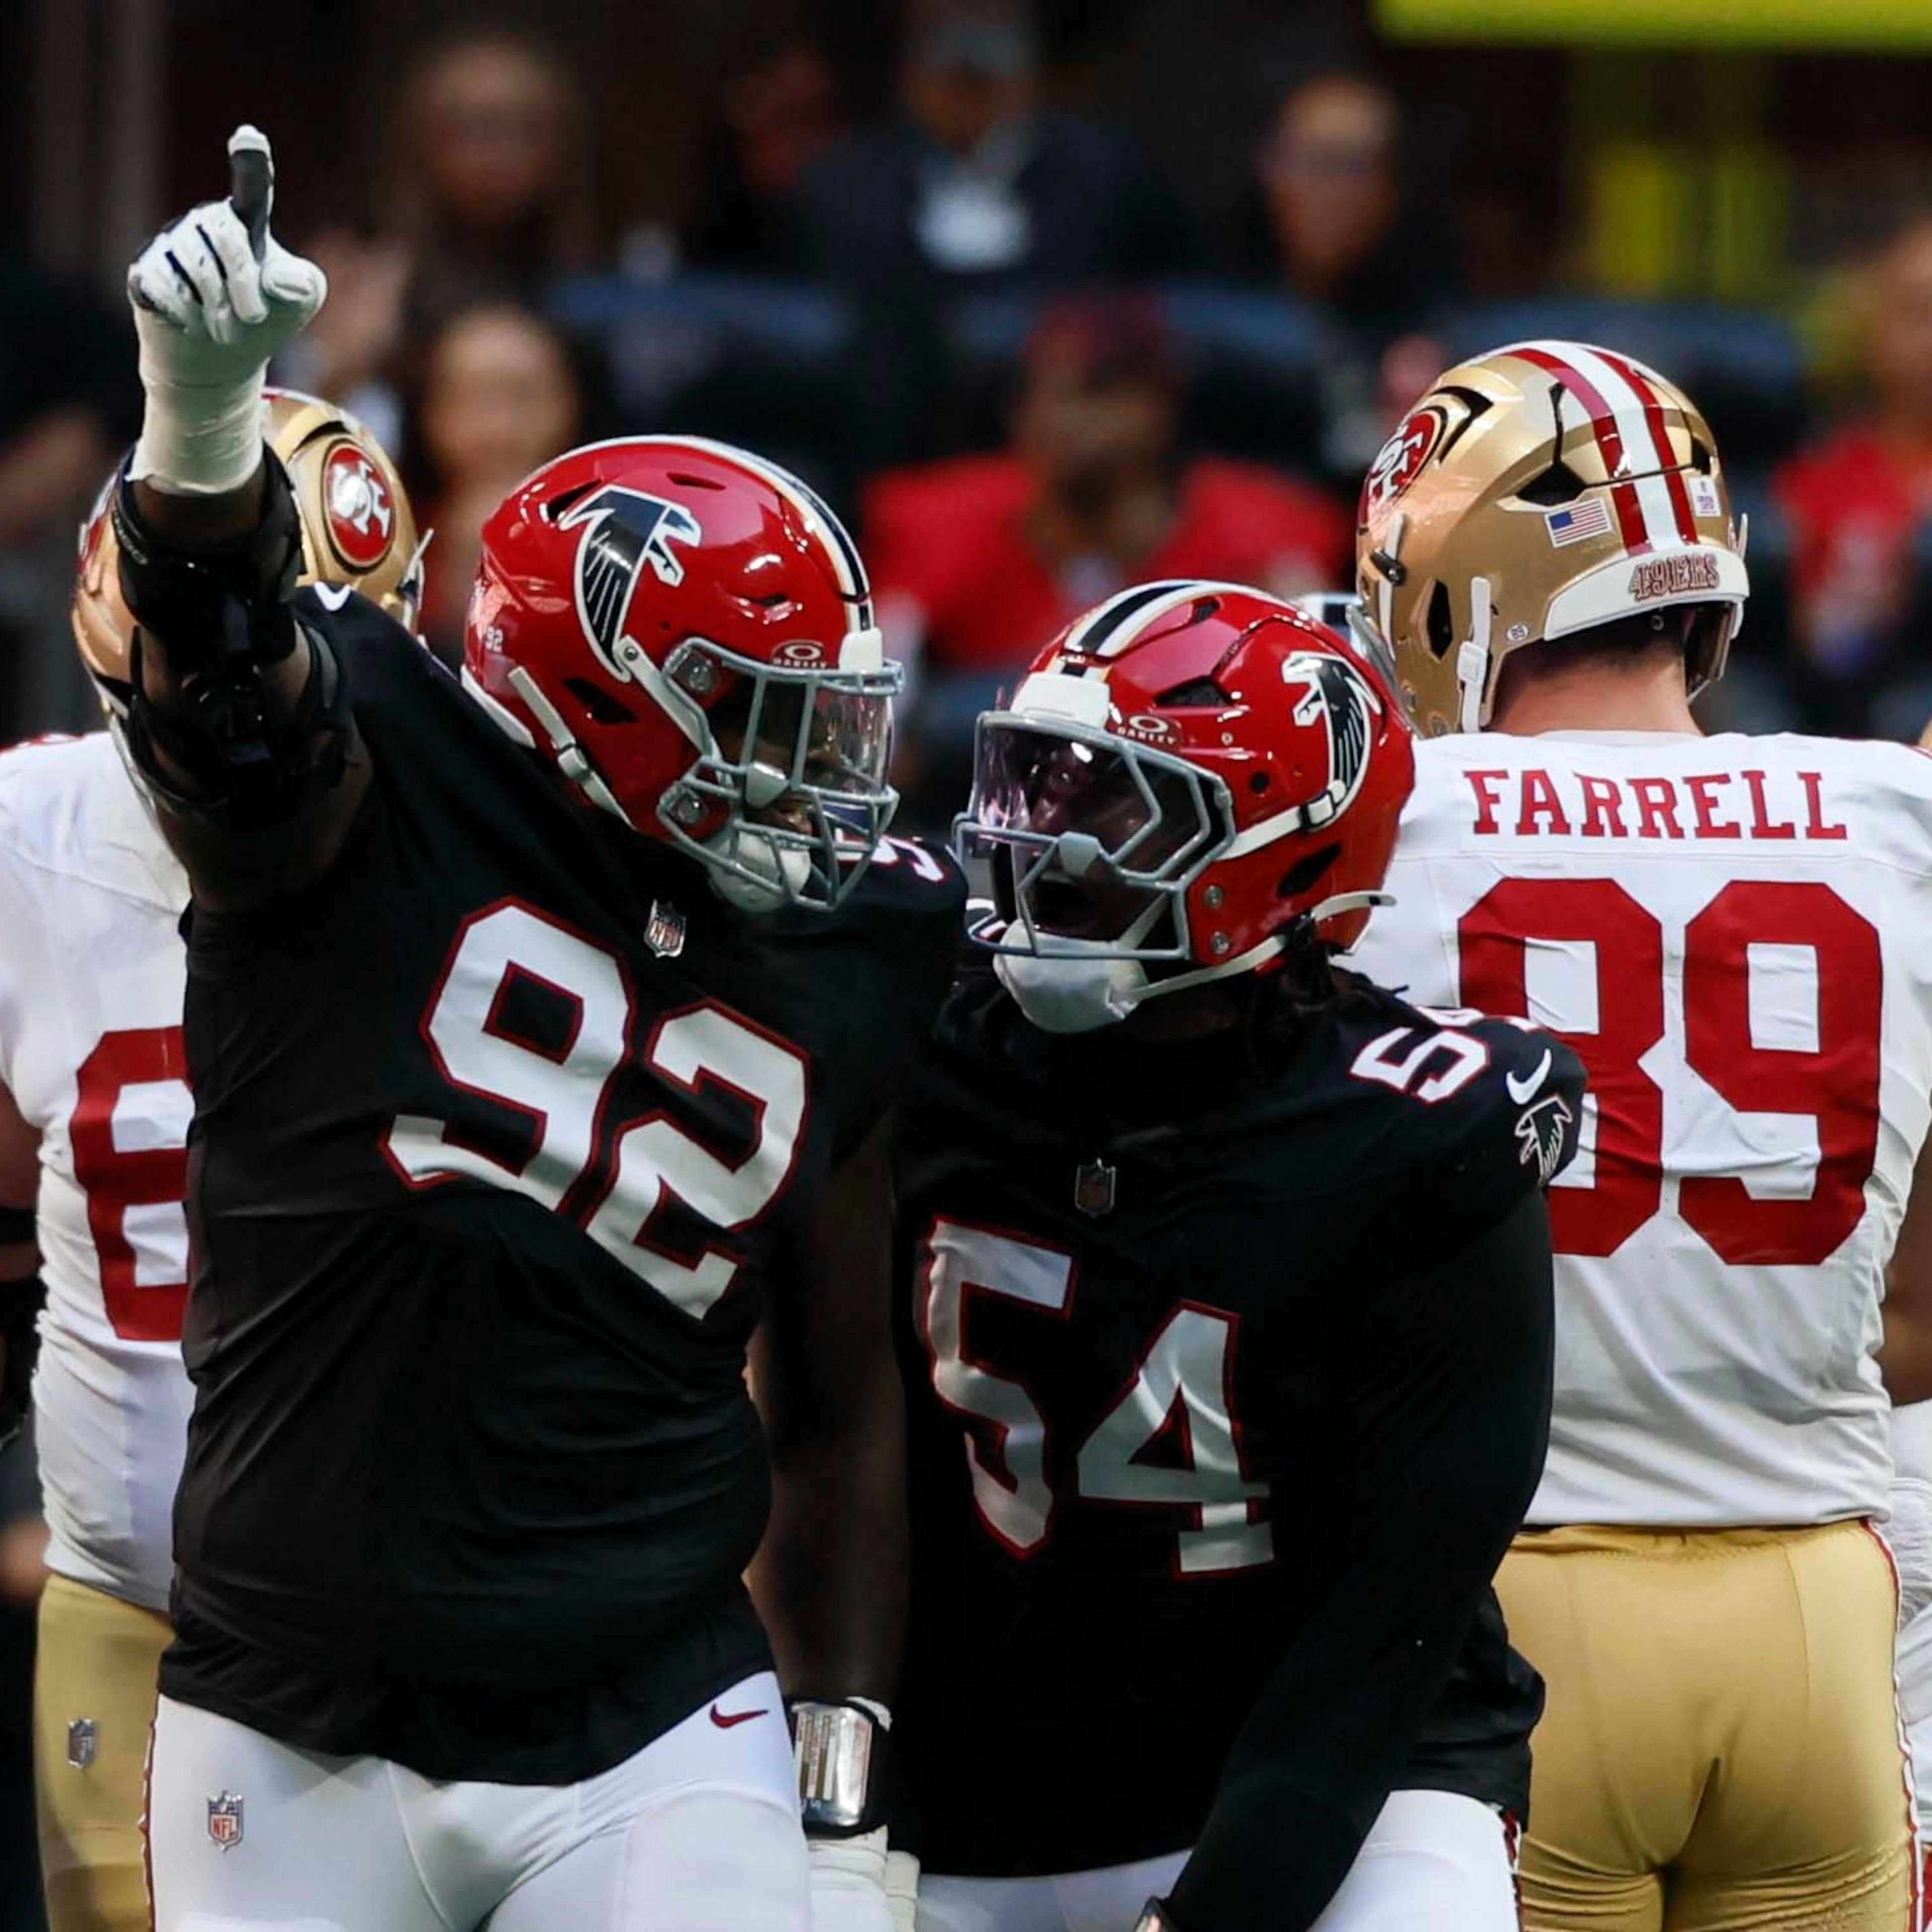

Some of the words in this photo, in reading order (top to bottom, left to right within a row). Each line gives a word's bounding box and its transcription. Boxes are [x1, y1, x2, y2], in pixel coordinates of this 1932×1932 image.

[1628, 554, 1720, 601] 49ERS
[485, 625, 503, 653] 92
[772, 657, 827, 669] OAKLEY
[1117, 726, 1176, 745] OAKLEY
[1463, 769, 1848, 839] FARRELL
[1347, 1005, 1540, 1107] 5
[1458, 876, 1884, 1266] 89
[376, 895, 811, 1320] 92
[921, 1213, 1275, 1581] 54
[213, 1816, 239, 1840] NFL
